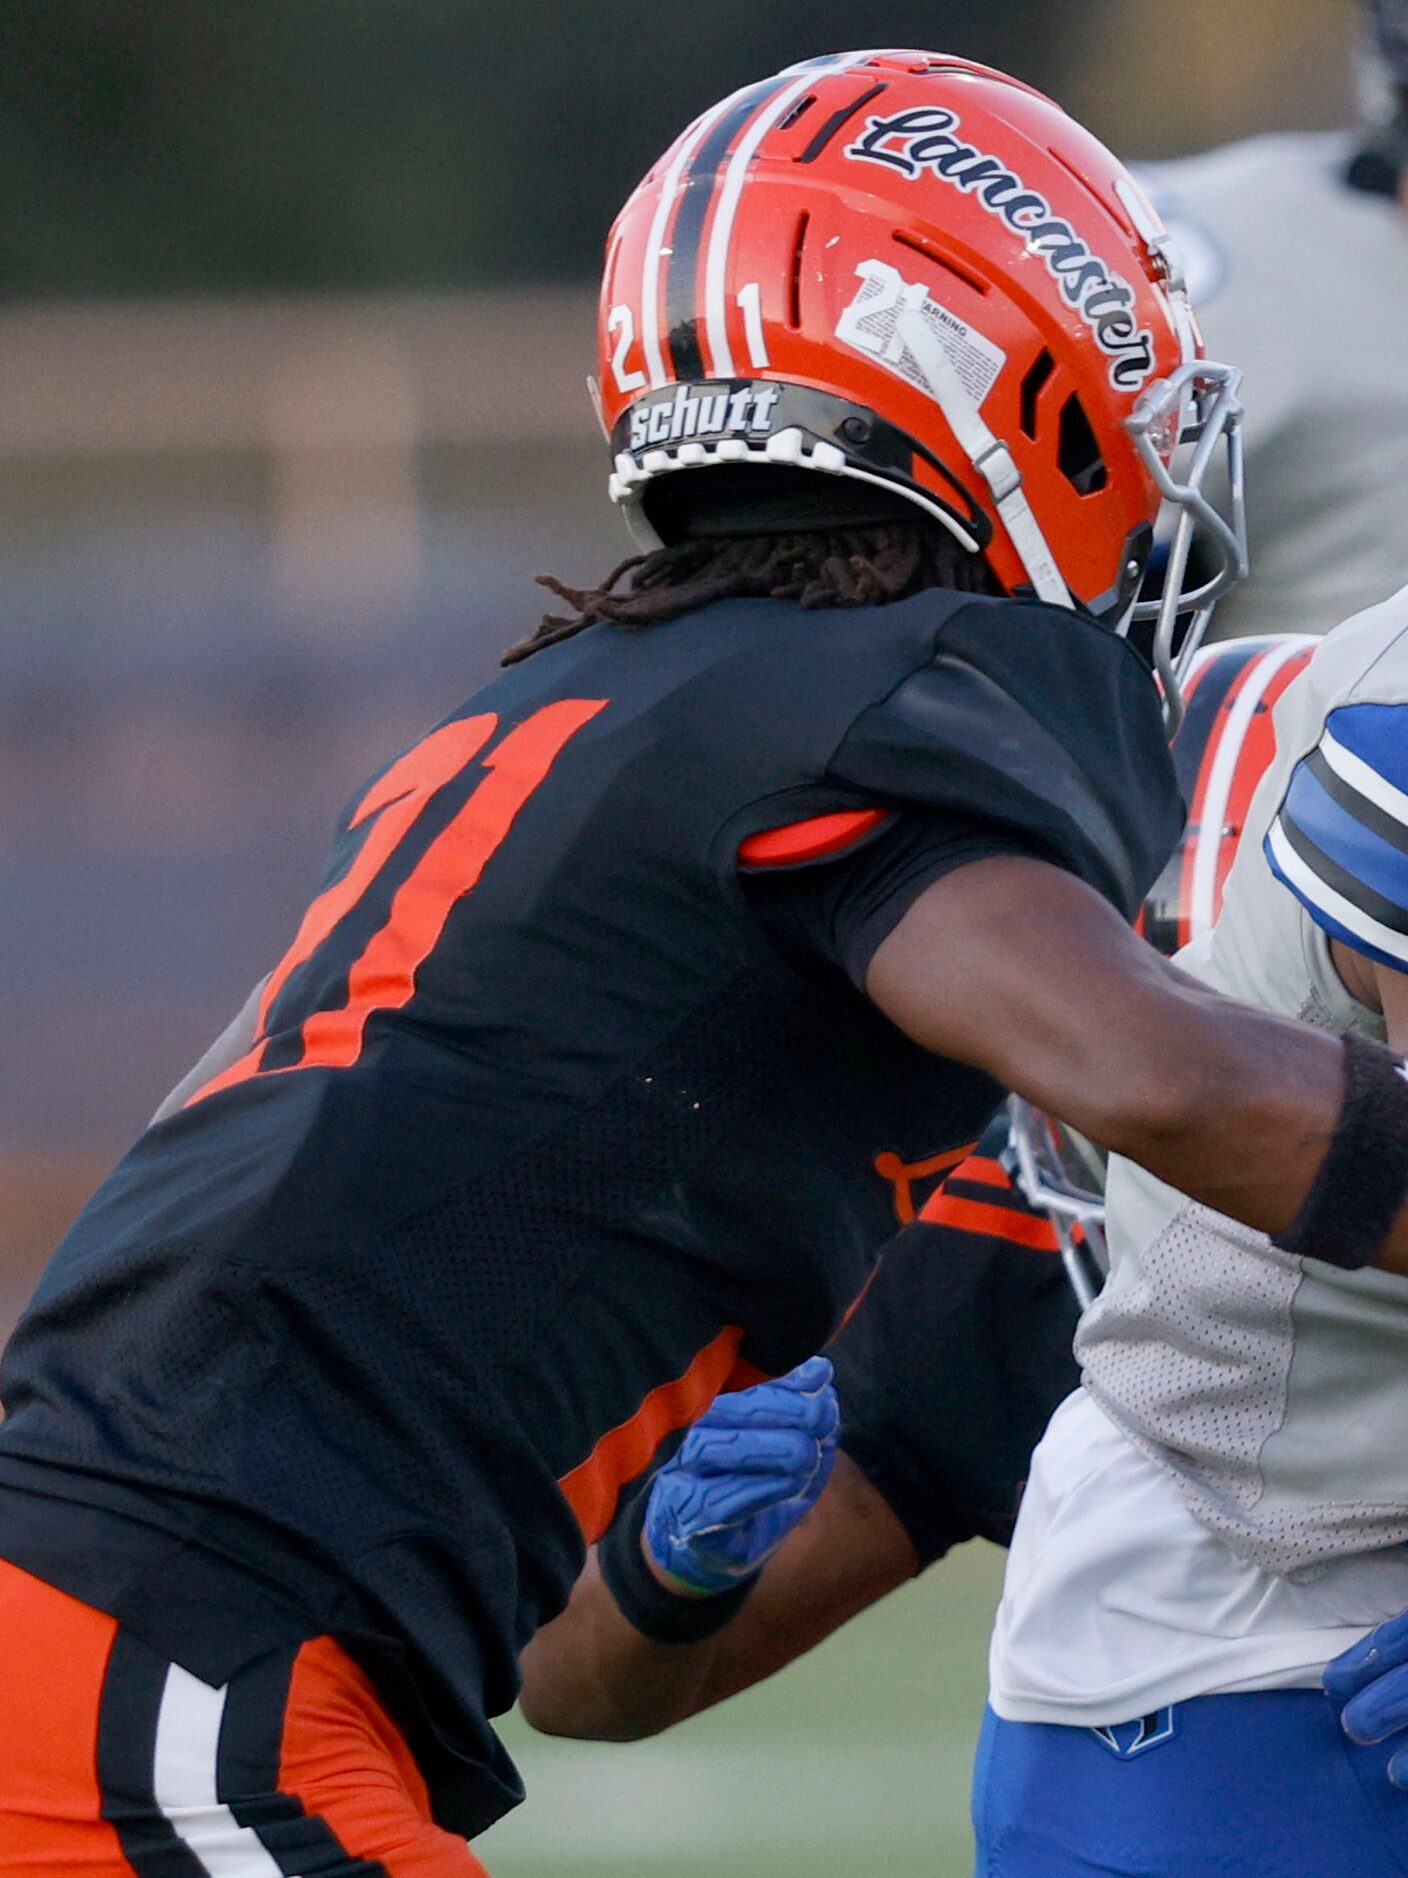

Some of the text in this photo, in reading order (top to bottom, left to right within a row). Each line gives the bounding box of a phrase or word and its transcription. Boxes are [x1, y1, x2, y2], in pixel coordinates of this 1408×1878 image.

[844, 105, 1155, 391] Lancaster
[921, 299, 968, 338] ARNING
[630, 384, 778, 450] schutt
